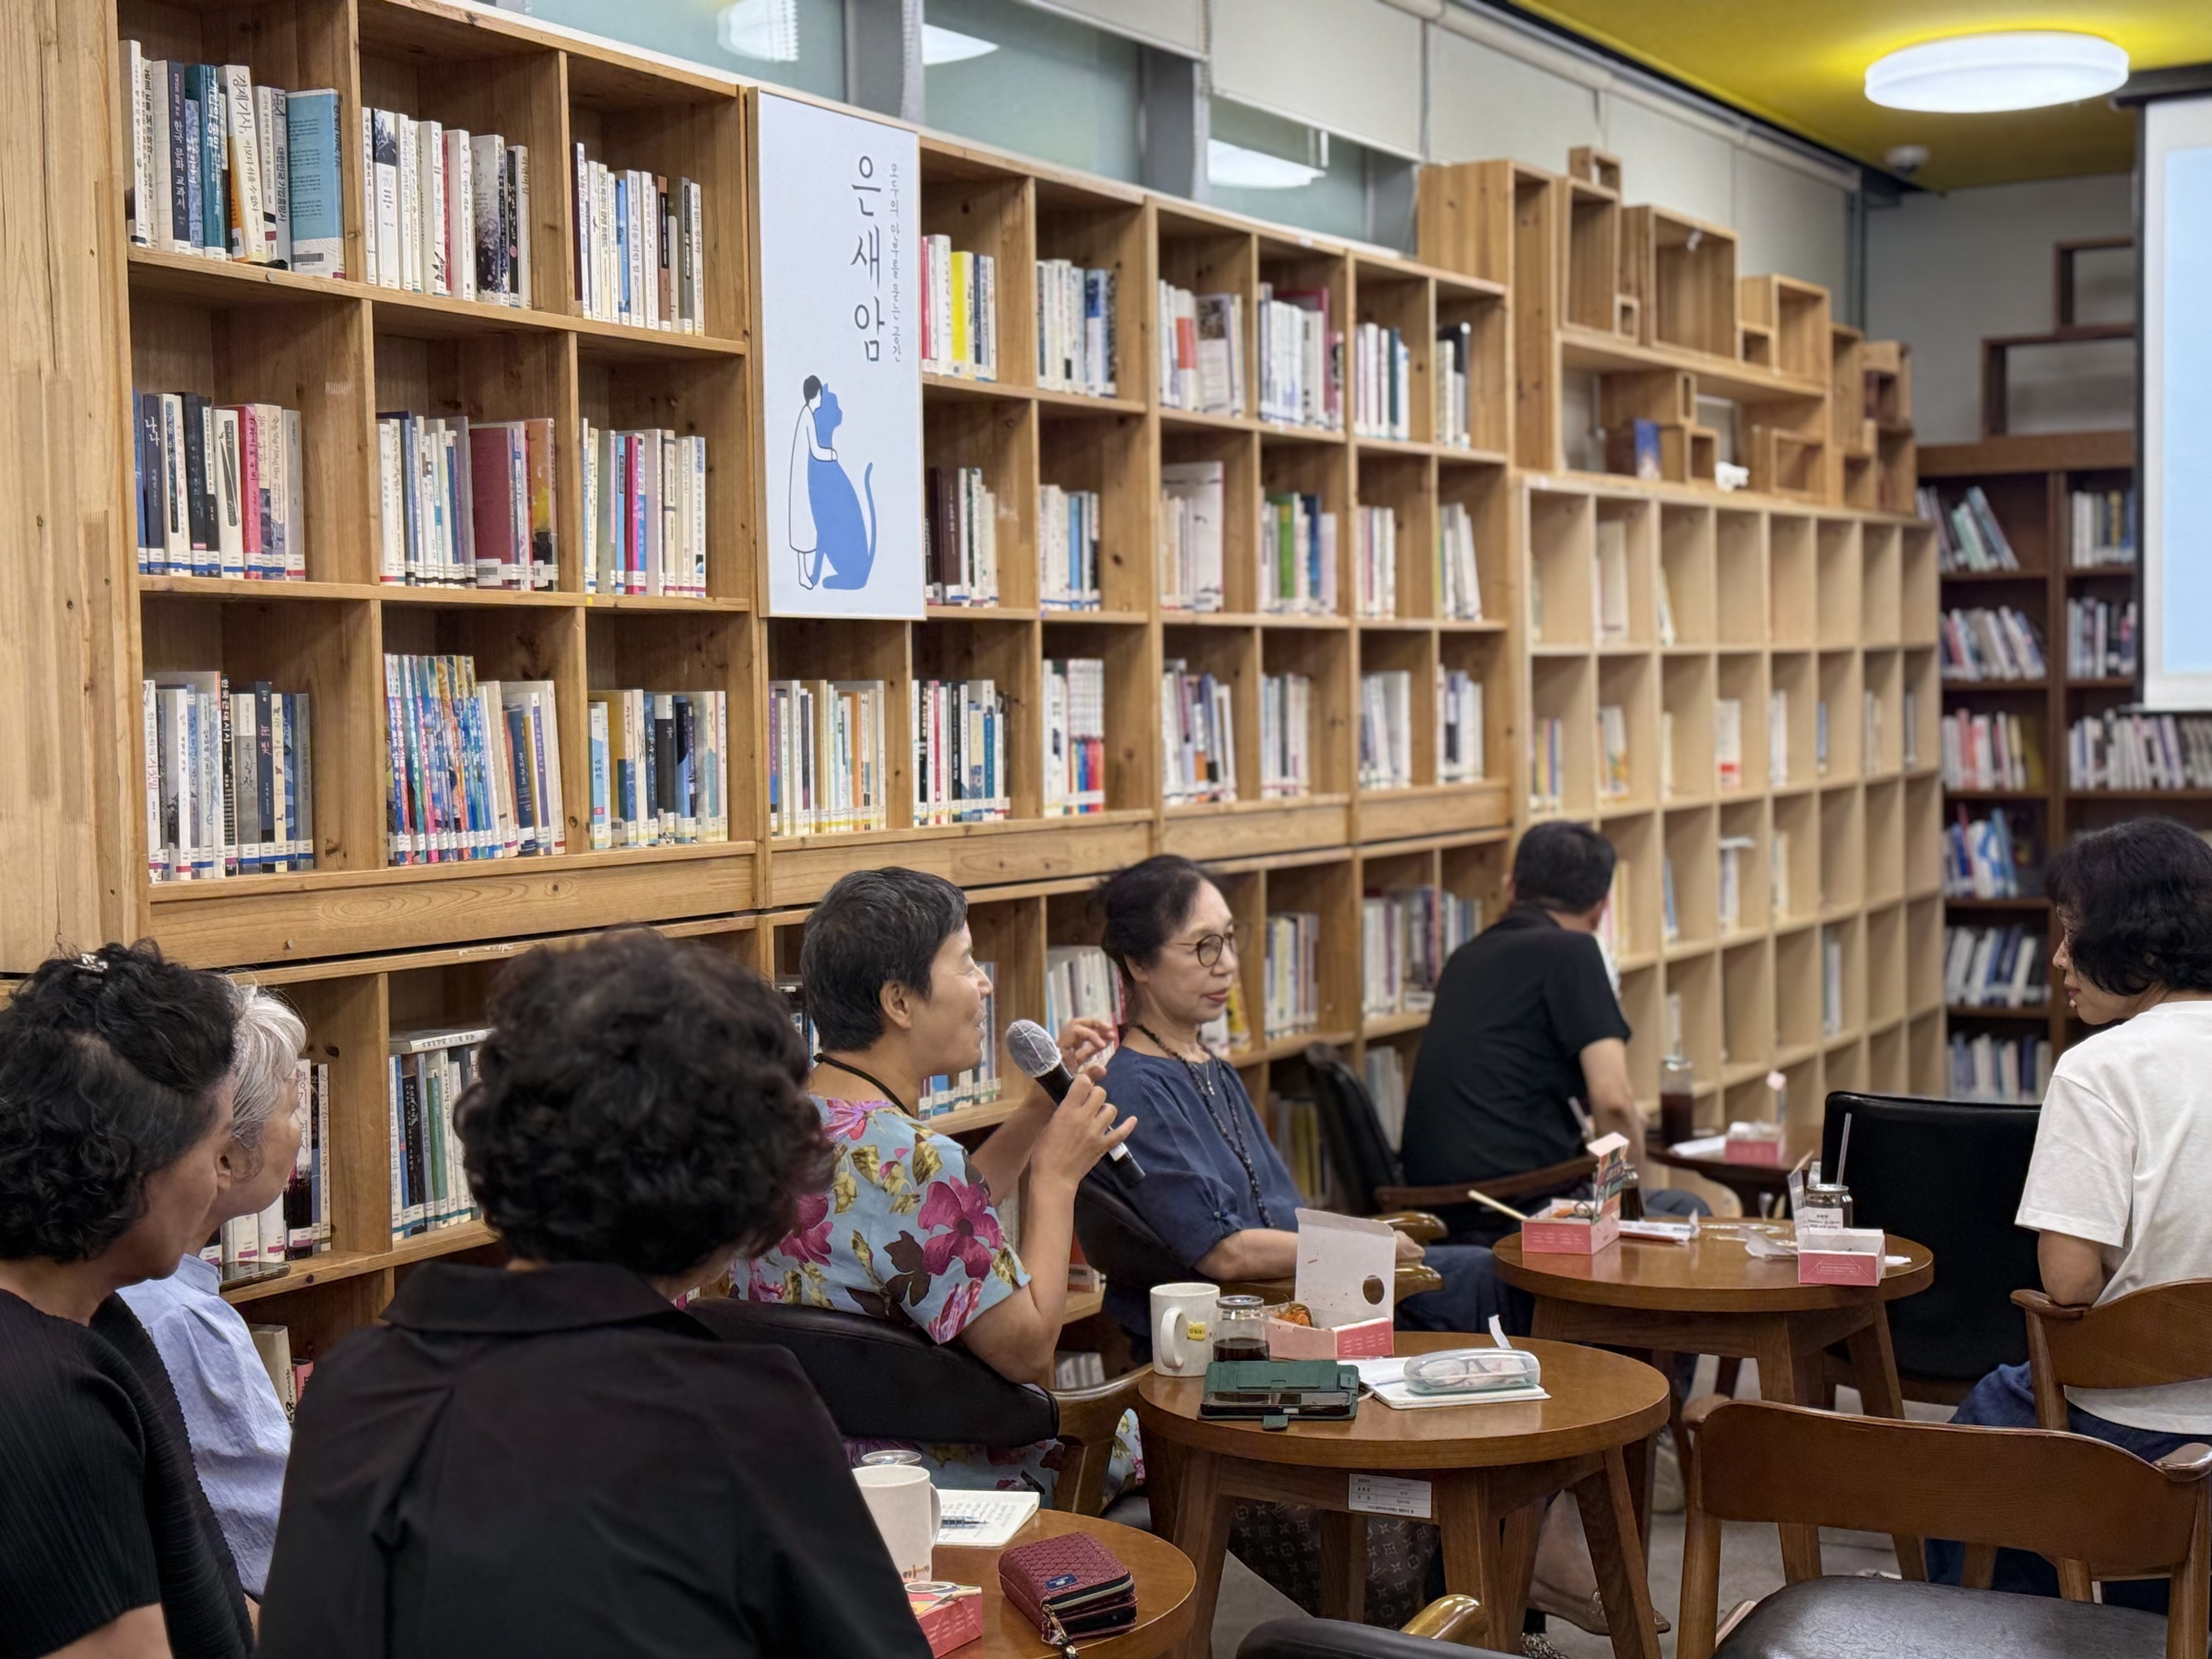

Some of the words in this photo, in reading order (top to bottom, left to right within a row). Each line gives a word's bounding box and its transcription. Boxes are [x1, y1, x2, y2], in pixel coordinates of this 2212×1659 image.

[173, 120, 183, 143] 한국
[174, 148, 184, 171] 문화
[244, 140, 255, 165] 이보다
[276, 146, 286, 181] 대한민국
[246, 167, 256, 182] 쉬울
[247, 184, 257, 194] 수
[889, 163, 900, 217] 모두의
[176, 176, 186, 210] 교과서
[250, 195, 259, 212] 없다
[850, 155, 885, 363] 은새암
[890, 222, 900, 280] 안부를
[891, 284, 901, 320] 묻는
[891, 326, 901, 363] 공간
[221, 679, 231, 742] 한국근대시사
